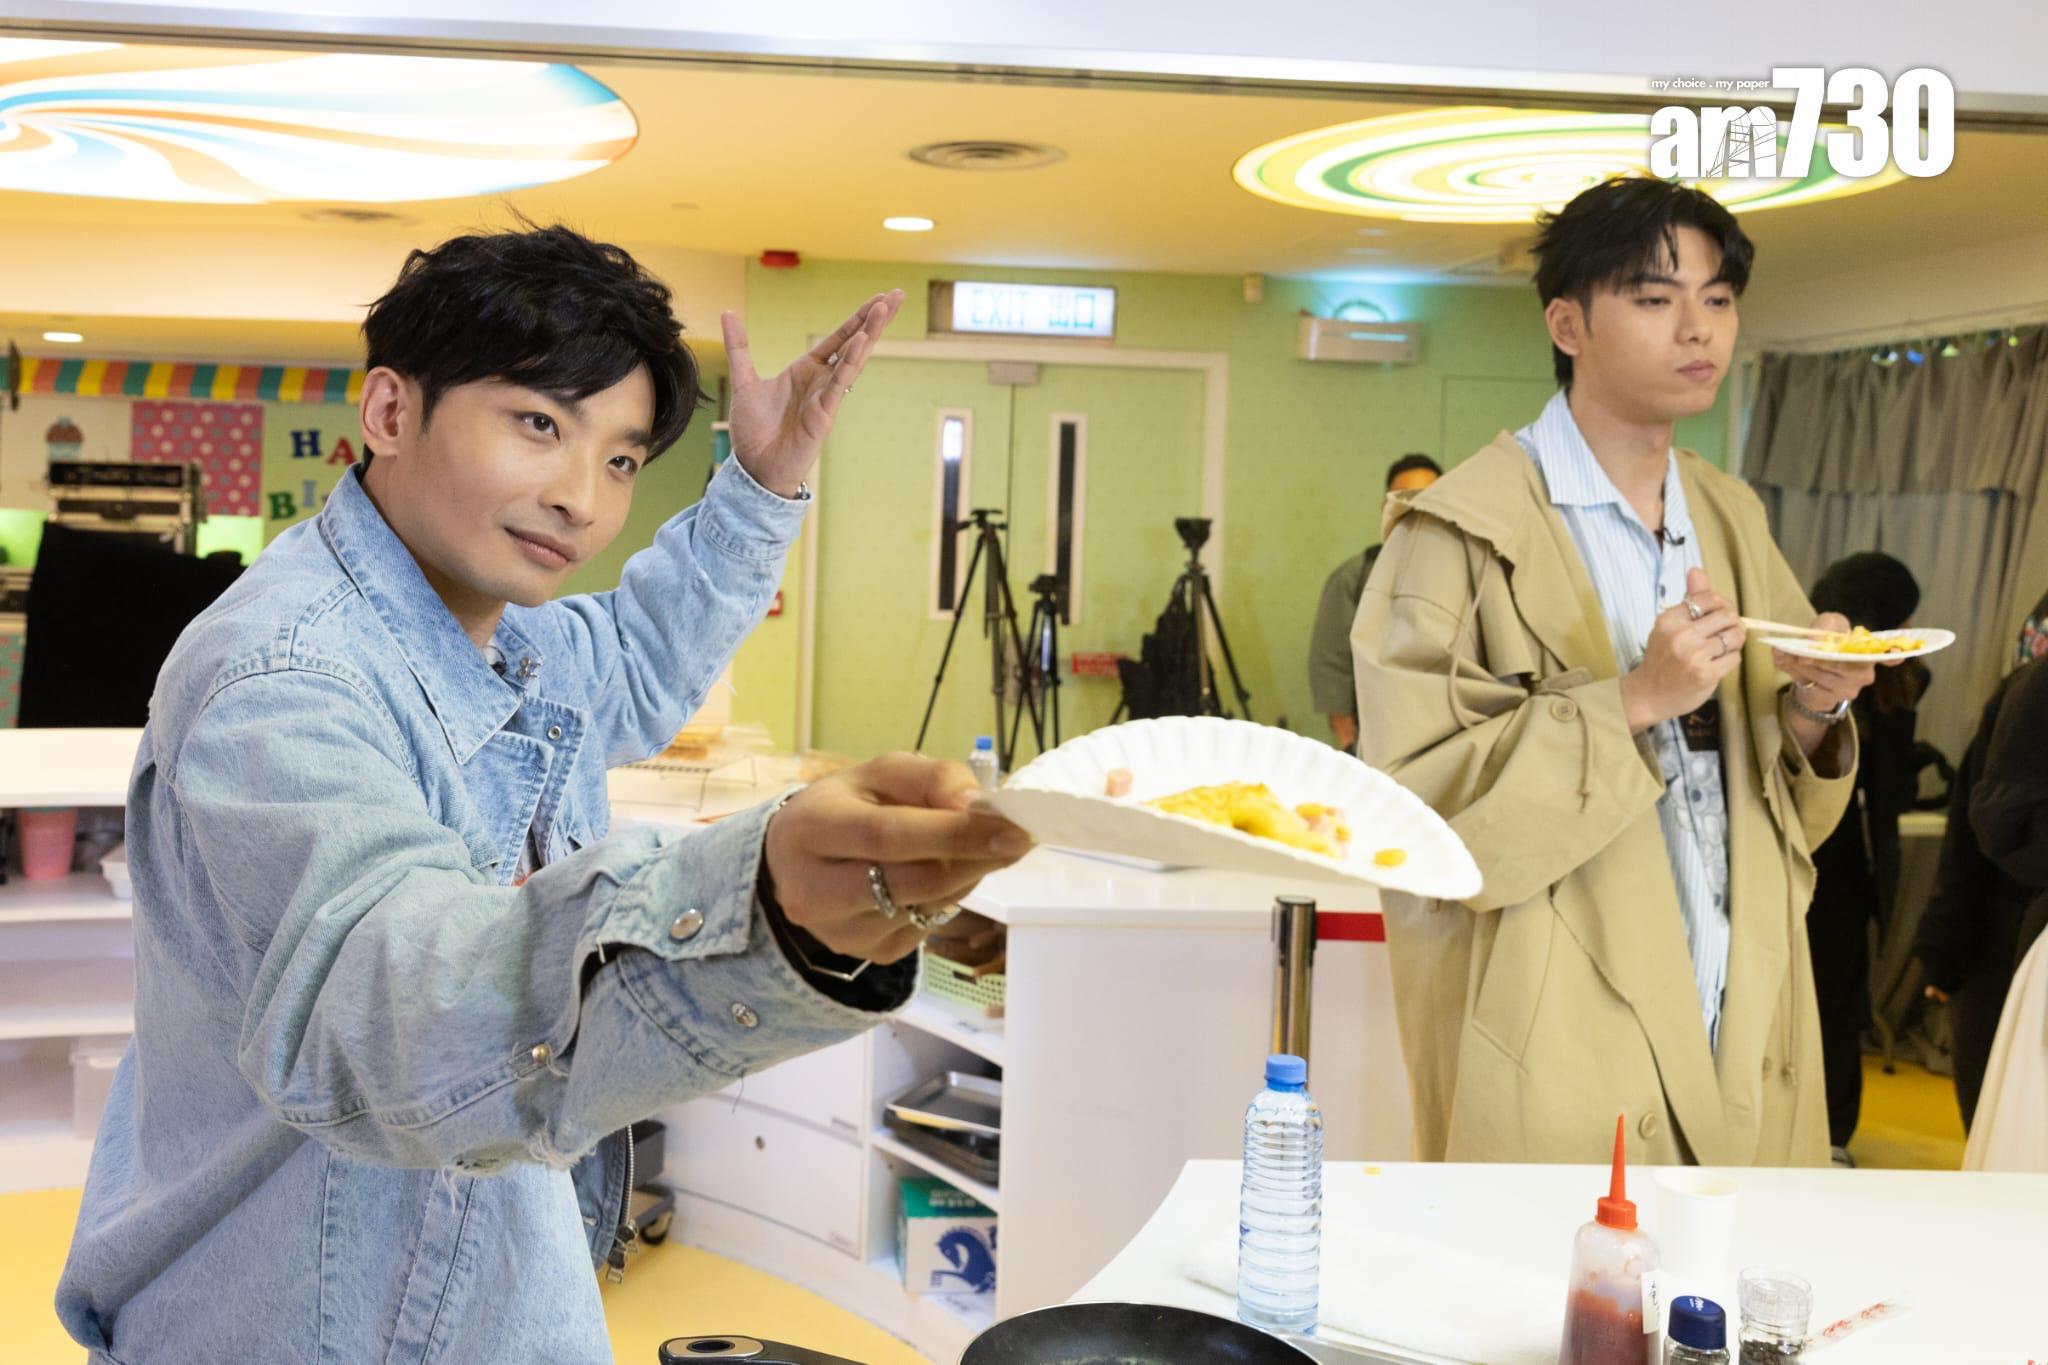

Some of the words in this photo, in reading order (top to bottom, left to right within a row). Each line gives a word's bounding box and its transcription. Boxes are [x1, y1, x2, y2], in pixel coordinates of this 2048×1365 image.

[971, 289, 1029, 327] EXIT
[1049, 293, 1096, 329] 出口
[267, 479, 330, 519] BI
